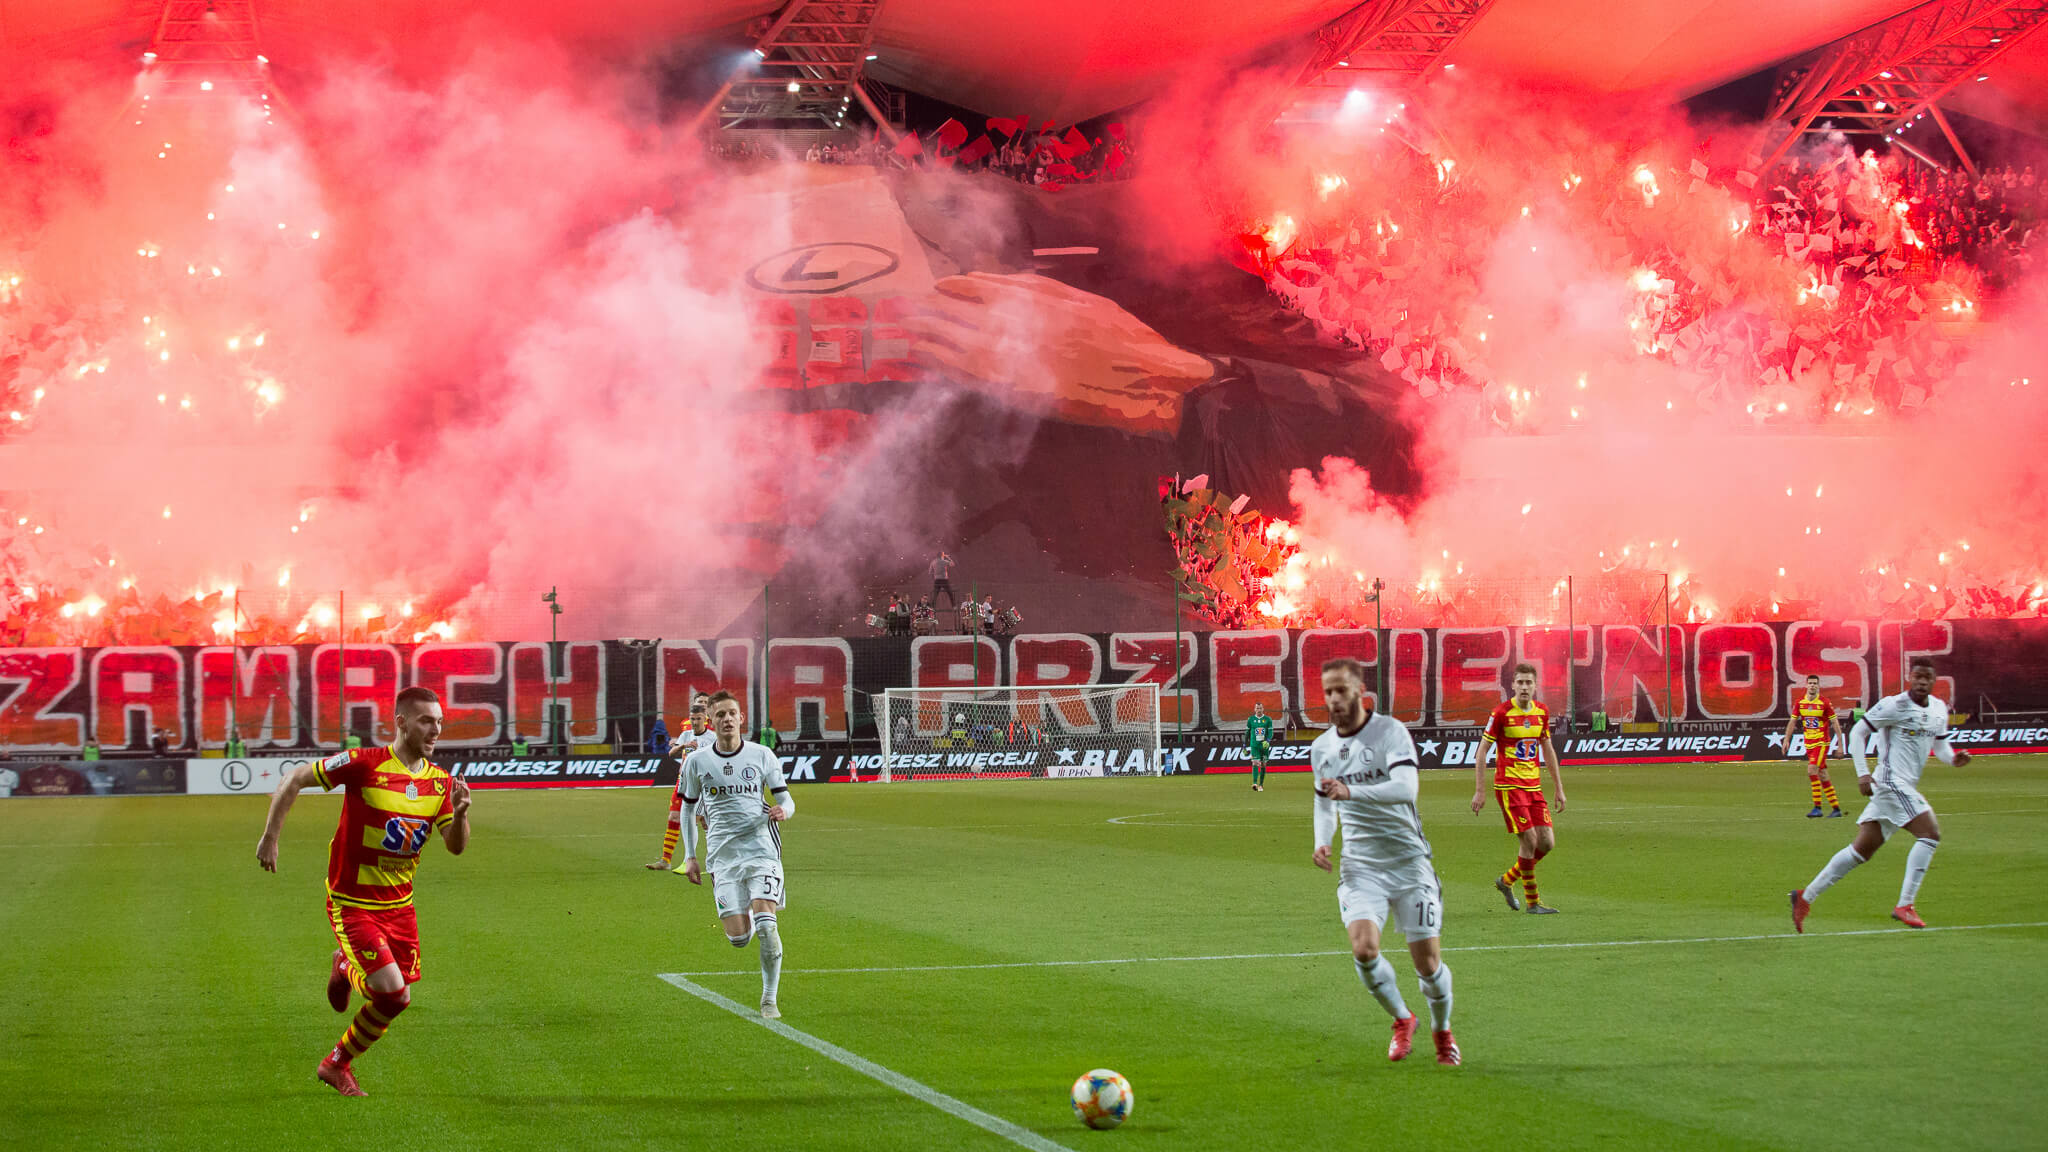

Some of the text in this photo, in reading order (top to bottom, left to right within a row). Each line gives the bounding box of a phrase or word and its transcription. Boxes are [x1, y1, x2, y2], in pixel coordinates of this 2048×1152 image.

[0, 641, 607, 750] ZAMACH
[656, 636, 853, 743] NA
[1207, 746, 1218, 761] I
[1514, 739, 1537, 760] STS
[1564, 735, 1751, 753] I MOŻESZ WIĘCEJ!
[451, 758, 662, 778] I MOŻESZ WIĘCEJ!
[833, 755, 844, 770] I
[847, 751, 946, 770] MOŻESZ
[947, 751, 1039, 767] WIĘCEJ!
[1081, 747, 1195, 773] BLACK
[1069, 769, 1092, 777] PHN
[704, 784, 758, 796] FORTUNA
[381, 816, 428, 853] STS
[763, 875, 781, 897] 53
[1415, 901, 1435, 927] 16
